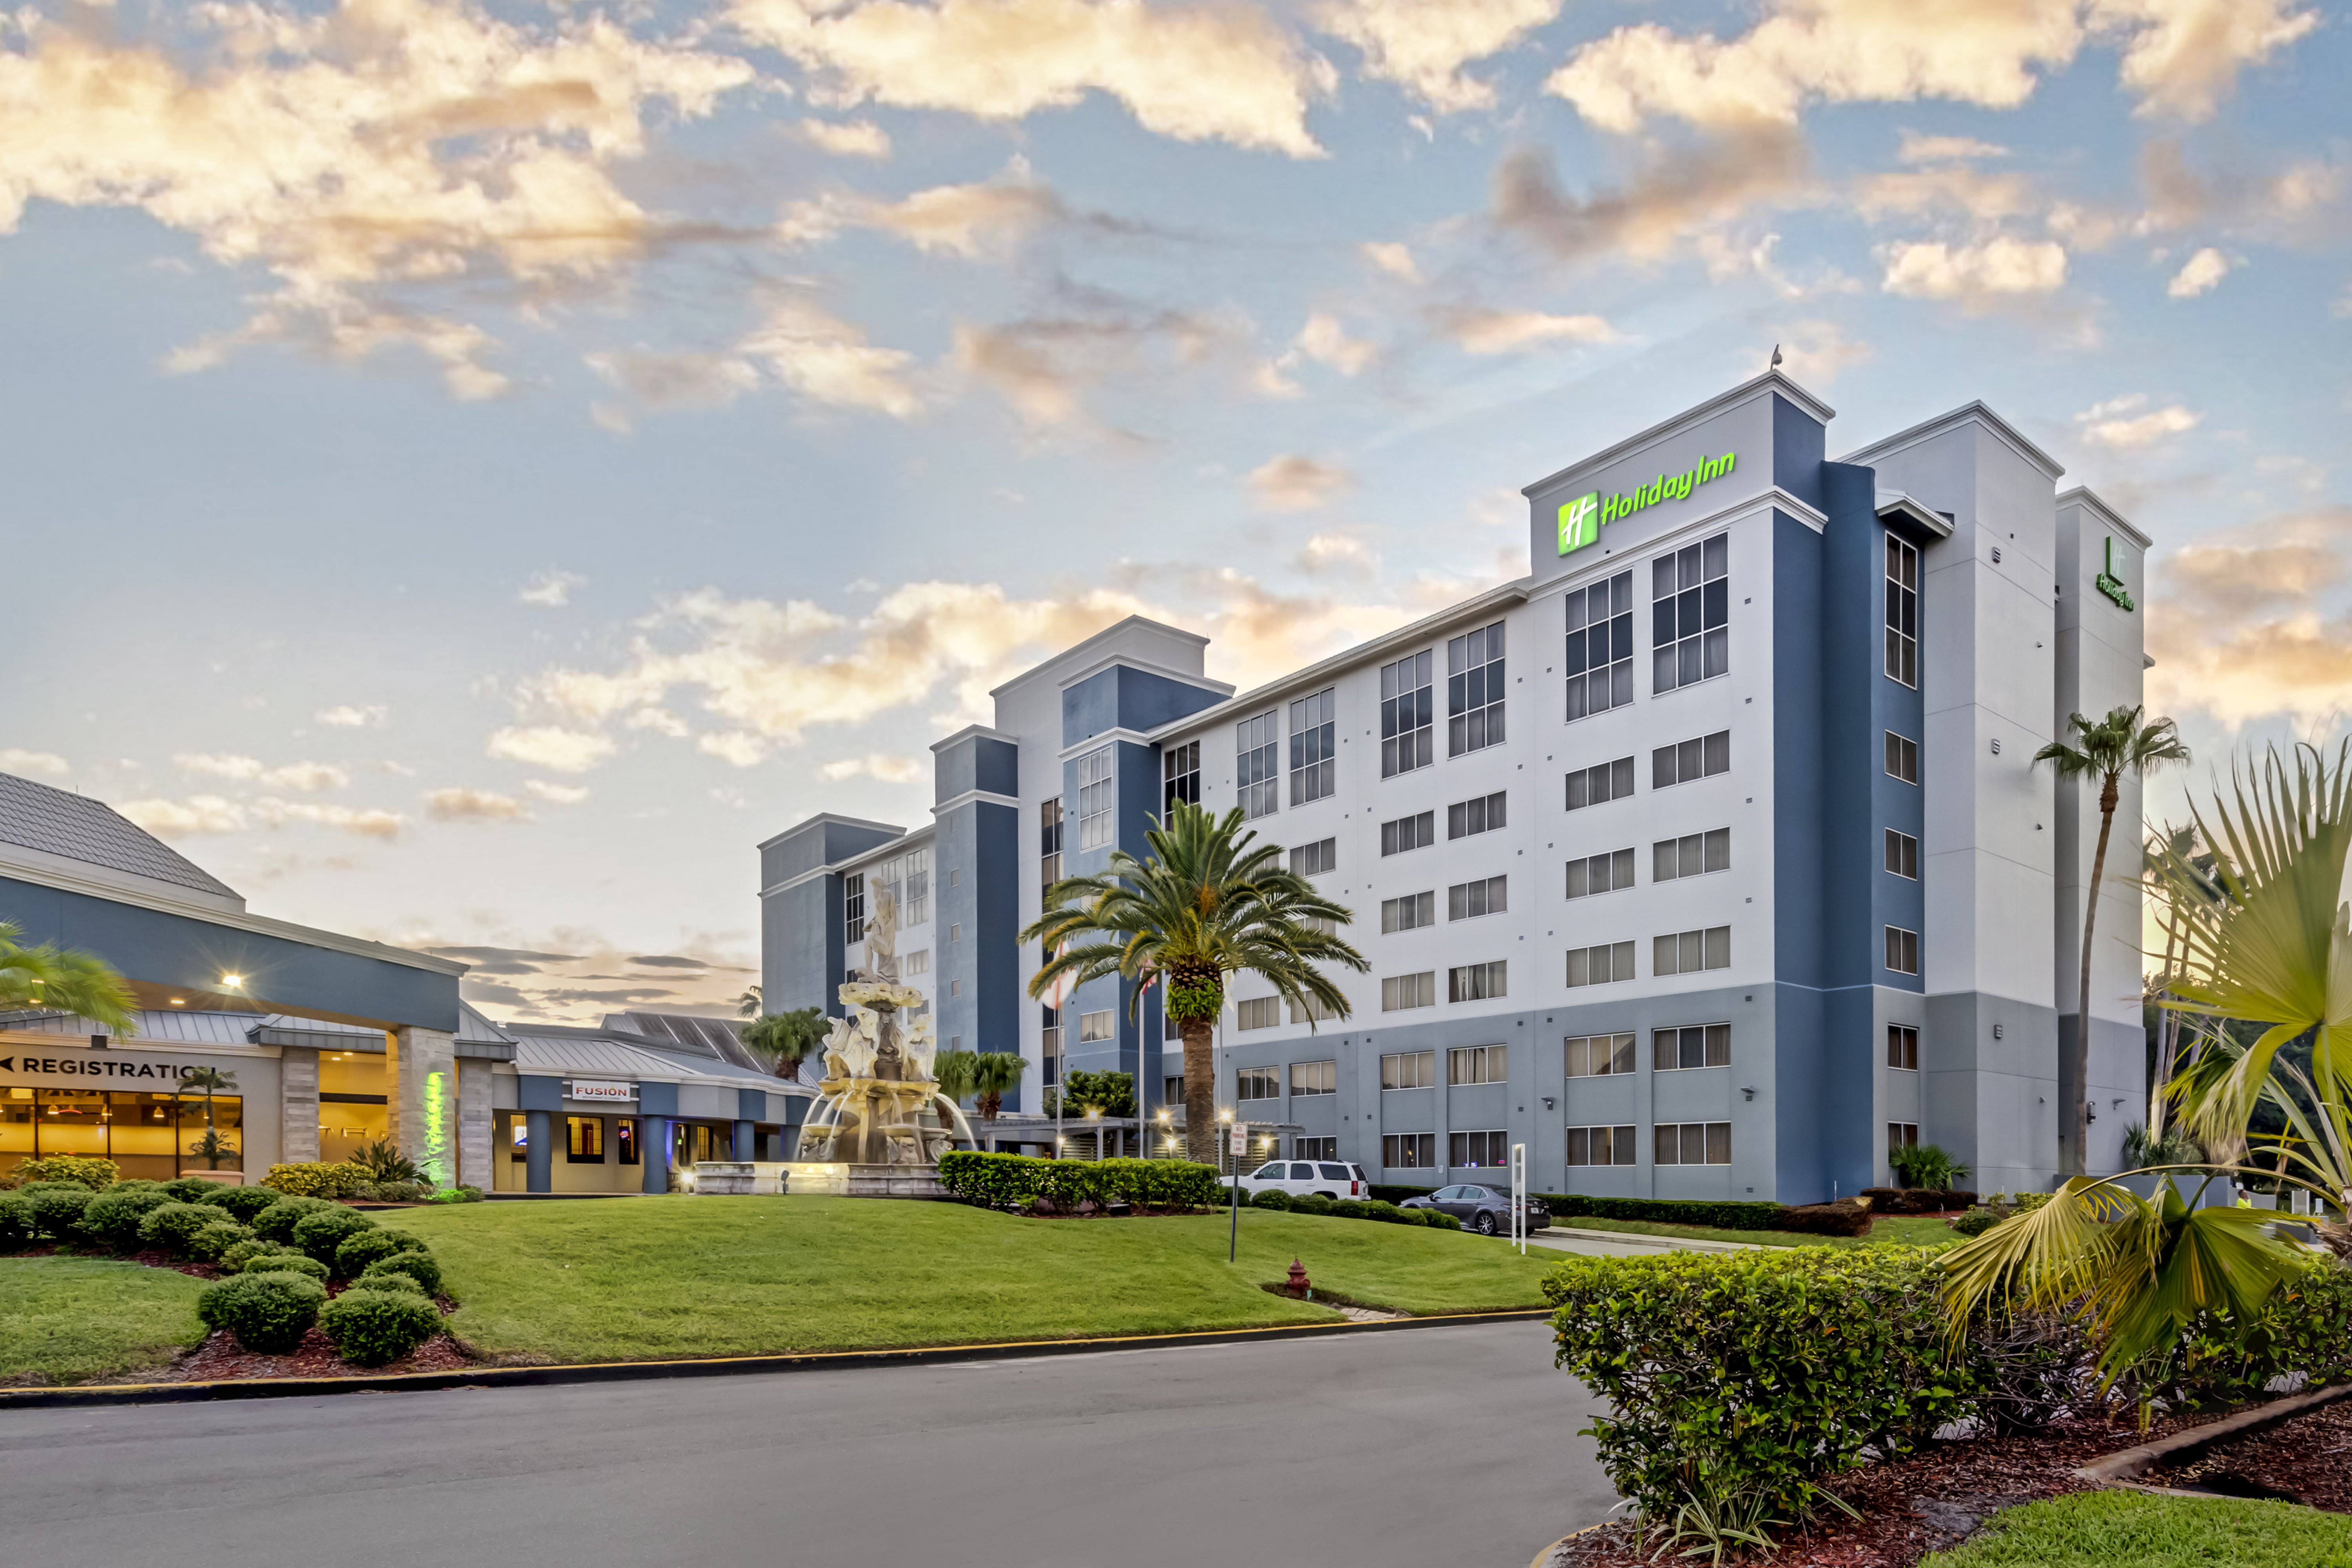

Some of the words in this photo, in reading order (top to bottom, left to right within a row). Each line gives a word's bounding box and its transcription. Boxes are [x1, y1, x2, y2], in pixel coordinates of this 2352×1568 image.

[1601, 470, 1693, 525] Holiday
[1696, 452, 1735, 485] Inn
[2099, 573, 2125, 607] Holiday
[2124, 591, 2134, 610] Inn
[23, 1058, 216, 1081] REGISTRATIO
[576, 1087, 627, 1096] FUSION
